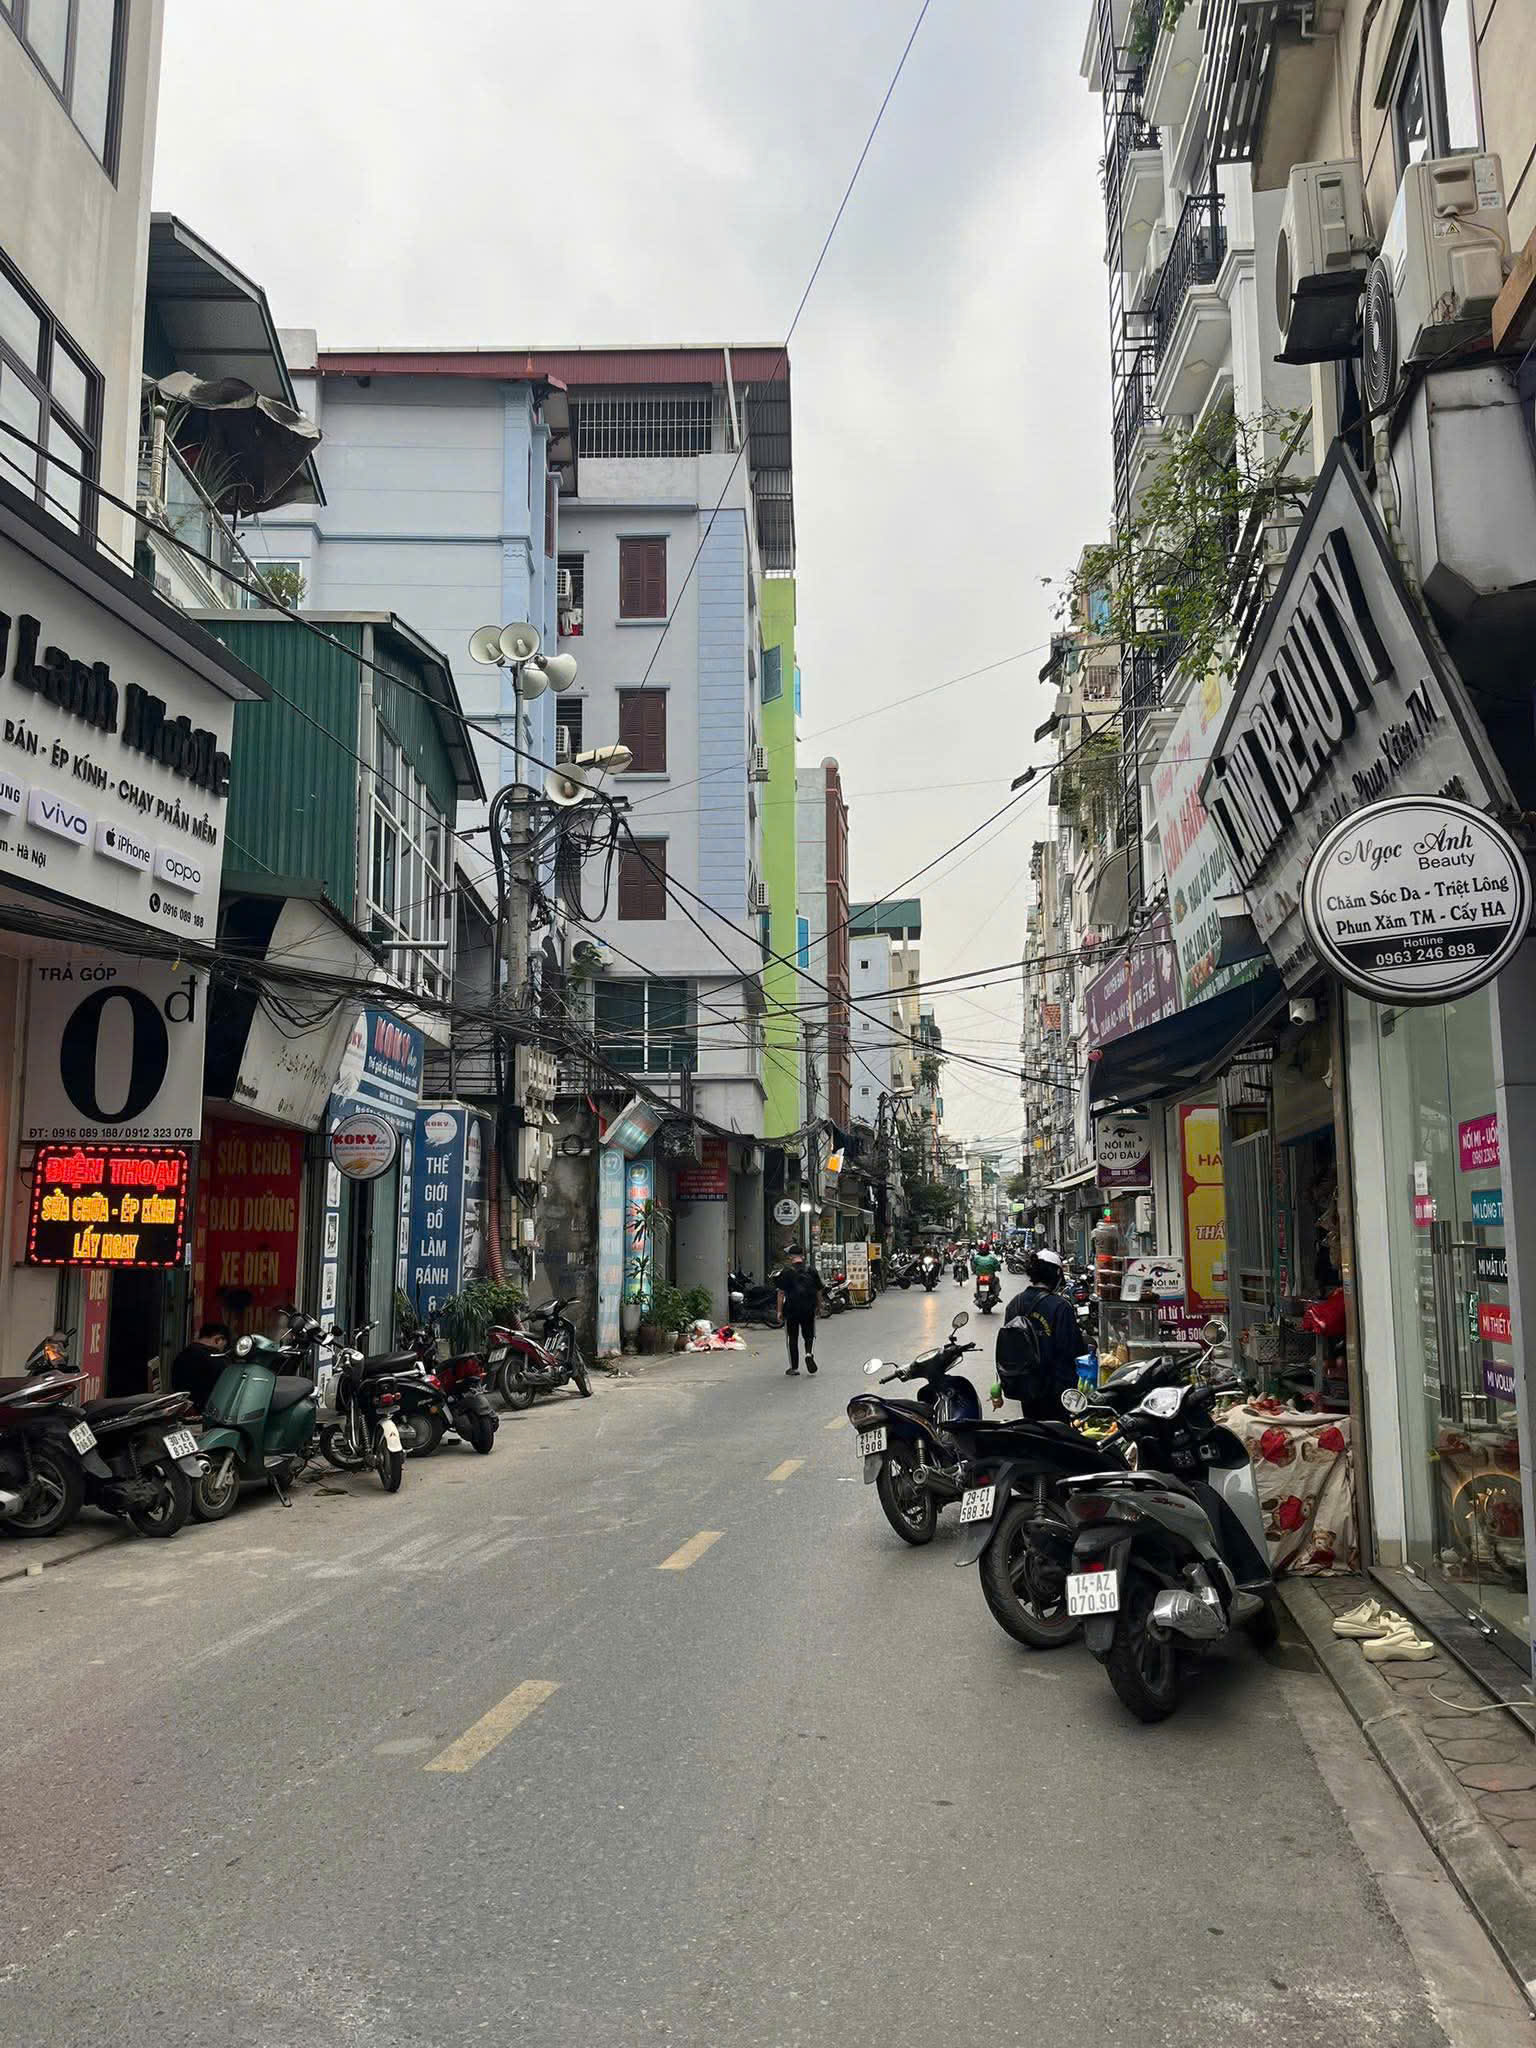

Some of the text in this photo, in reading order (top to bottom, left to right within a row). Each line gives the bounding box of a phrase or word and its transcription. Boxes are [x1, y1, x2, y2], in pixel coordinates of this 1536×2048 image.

[1250, 527, 1393, 810] BEAUTY
[122, 683, 231, 798] Mobile
[4, 719, 39, 755] BÁN
[51, 738, 69, 768] ÉP
[72, 754, 108, 790] KÍNH
[119, 780, 154, 813] CHẠY
[156, 798, 189, 832] PHẦN
[192, 813, 217, 845] MỀM
[41, 801, 88, 835] vivo
[16, 844, 29, 860] Hà
[31, 850, 47, 869] Nội
[117, 835, 151, 862] iPhone
[1338, 824, 1474, 871] Ngọc Ánh
[165, 858, 201, 883] oppo
[1418, 853, 1475, 870] Beauty
[1327, 896, 1367, 911] Chăm
[1369, 889, 1397, 906] Sóc
[1399, 886, 1421, 901] Da
[1434, 880, 1470, 898] Triệt
[1472, 875, 1510, 893] Lông
[162, 902, 178, 918] 0916
[179, 907, 192, 923] 089
[1336, 919, 1372, 936] Phun
[1375, 914, 1407, 931] Xăm
[1409, 908, 1436, 926] TM
[1450, 902, 1478, 922] Cấy
[1481, 900, 1506, 917] HA
[1403, 936, 1444, 948] Hotline
[1375, 943, 1476, 966] 0963 246 898
[38, 963, 117, 981] TRẢ GÓP
[29, 1128, 49, 1138] ĐT:
[52, 1128, 76, 1138] 0916
[79, 1128, 98, 1138] 089
[152, 1128, 171, 1138] 323
[174, 1128, 193, 1138] 078
[333, 1134, 377, 1144] KOKY
[426, 1153, 452, 1174] THẾ
[424, 1182, 448, 1202] GIỚI
[120, 1193, 140, 1222] ÉP
[1472, 1203, 1480, 1219] MI
[1480, 1199, 1497, 1218] LÔNG
[426, 1208, 444, 1229] ĐỒ
[101, 1233, 140, 1259] NGAY
[421, 1236, 446, 1257] LÀM
[219, 1251, 240, 1286] XE
[415, 1263, 449, 1285] BÁNH
[1482, 1316, 1490, 1332] MI
[1486, 1370, 1495, 1388] MI
[861, 1440, 882, 1454] 1908
[966, 1489, 990, 1504] 29-C1
[962, 1502, 991, 1519] 588.34
[1075, 1573, 1110, 1594] 14-AZ
[1070, 1592, 1116, 1614] 070.90
